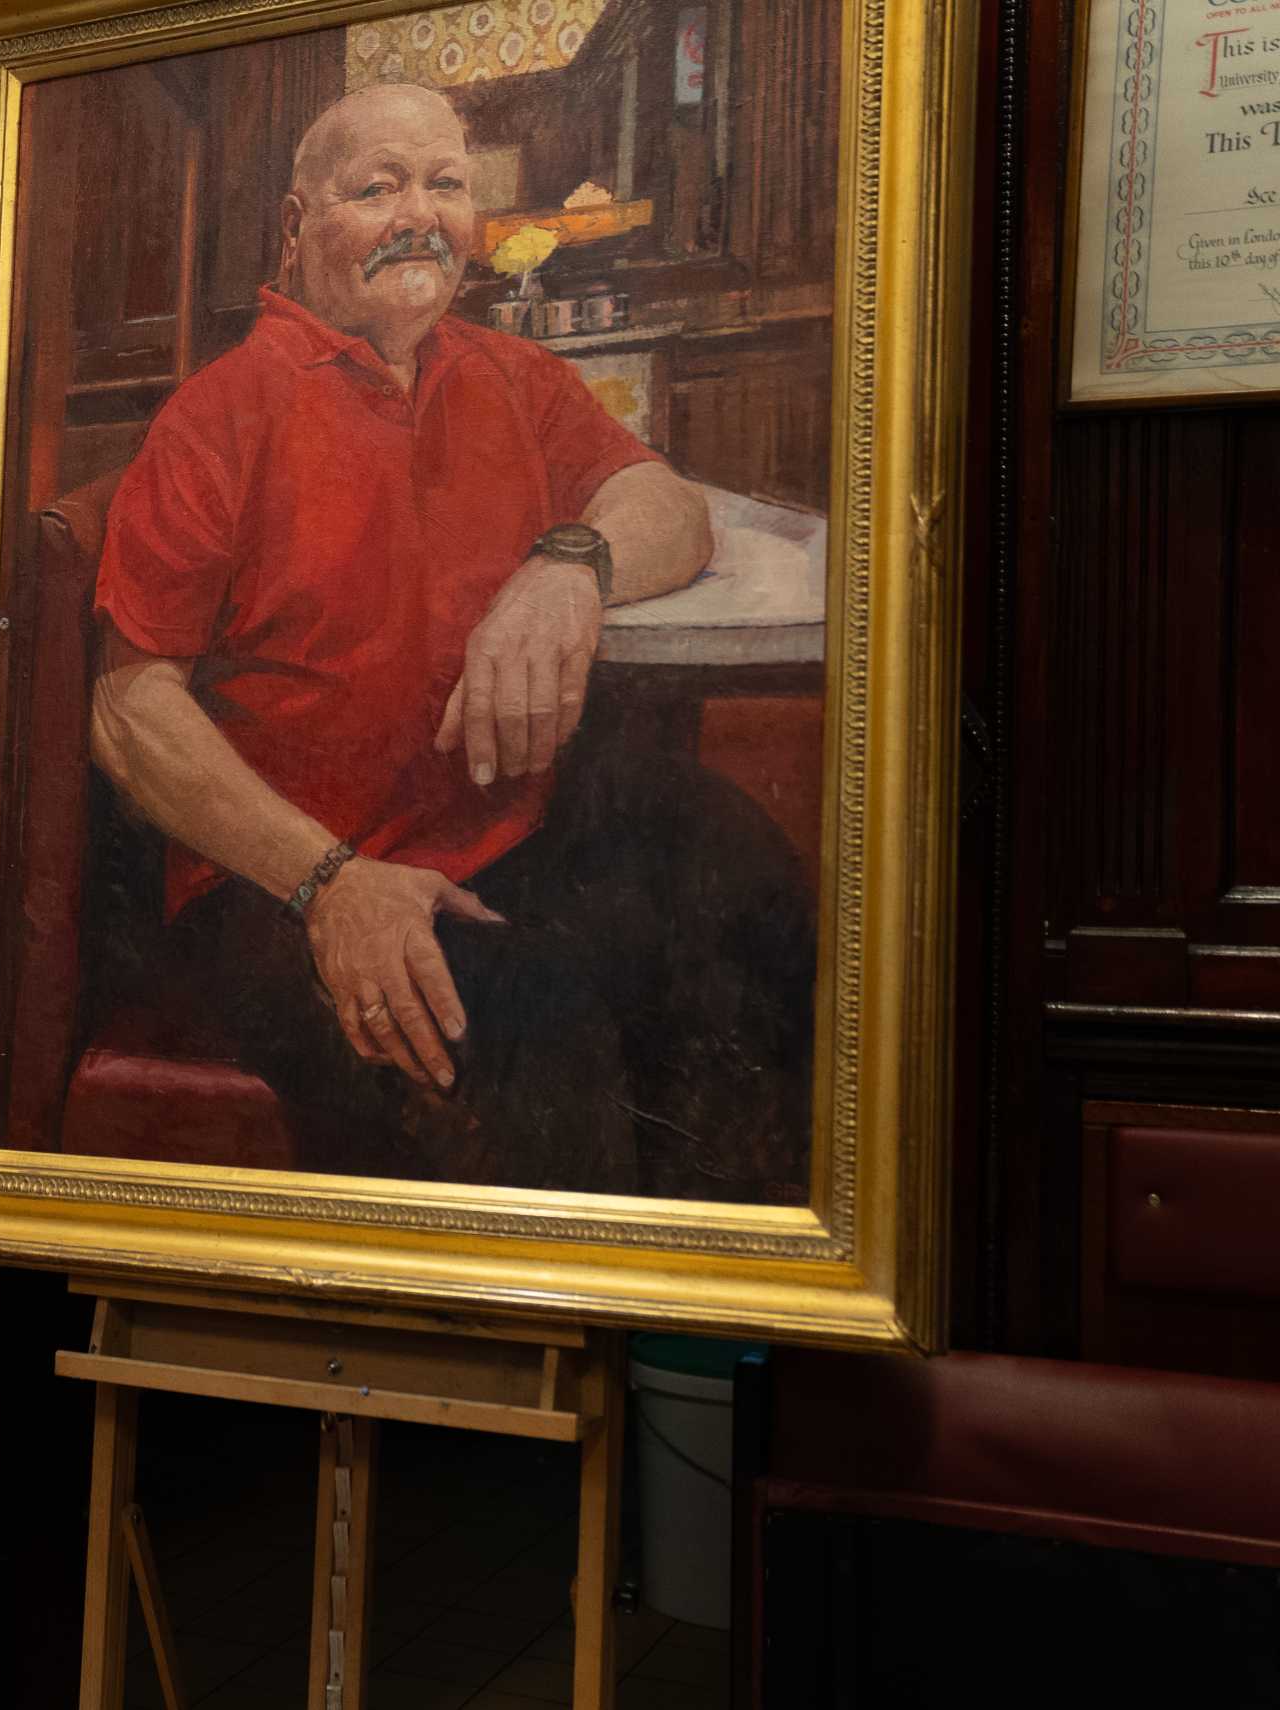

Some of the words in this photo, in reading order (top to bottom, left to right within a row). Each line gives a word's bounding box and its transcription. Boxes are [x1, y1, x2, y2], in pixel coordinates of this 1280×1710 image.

[1206, 10, 1232, 19] OPEN
[1249, 5, 1267, 13] ALL
[1196, 27, 1254, 98] This
[1219, 69, 1279, 88] University
[1239, 100, 1280, 116] was
[1205, 131, 1251, 154] This
[1243, 186, 1277, 205] Ice
[1183, 232, 1225, 256] Given
[1228, 236, 1240, 245] in
[1188, 259, 1211, 270] this
[1245, 252, 1266, 270] day
